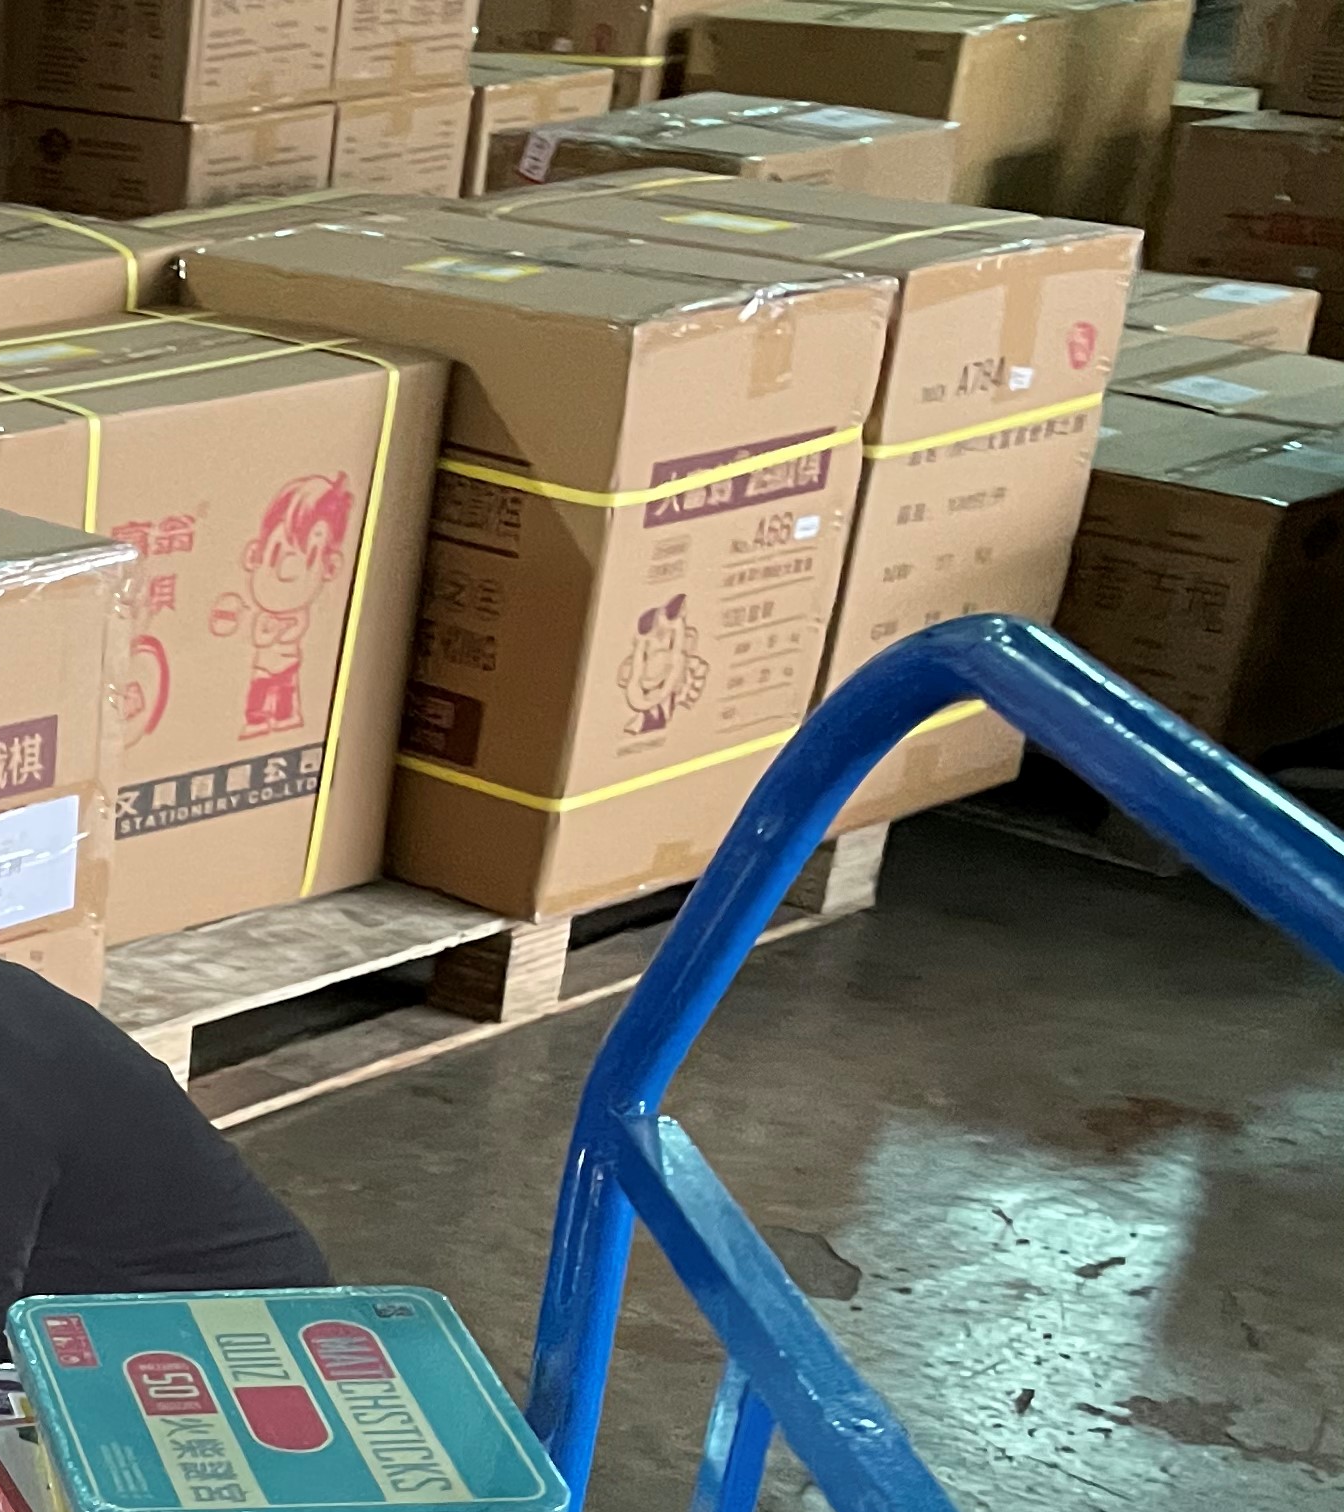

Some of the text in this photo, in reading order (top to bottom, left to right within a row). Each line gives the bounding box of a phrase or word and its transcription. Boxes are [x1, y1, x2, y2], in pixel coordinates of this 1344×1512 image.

[120, 788, 239, 835] STATIONERY
[215, 1332, 290, 1383] QUIZ
[142, 1372, 200, 1398] 50
[310, 1334, 457, 1493] MATCHSTICKS
